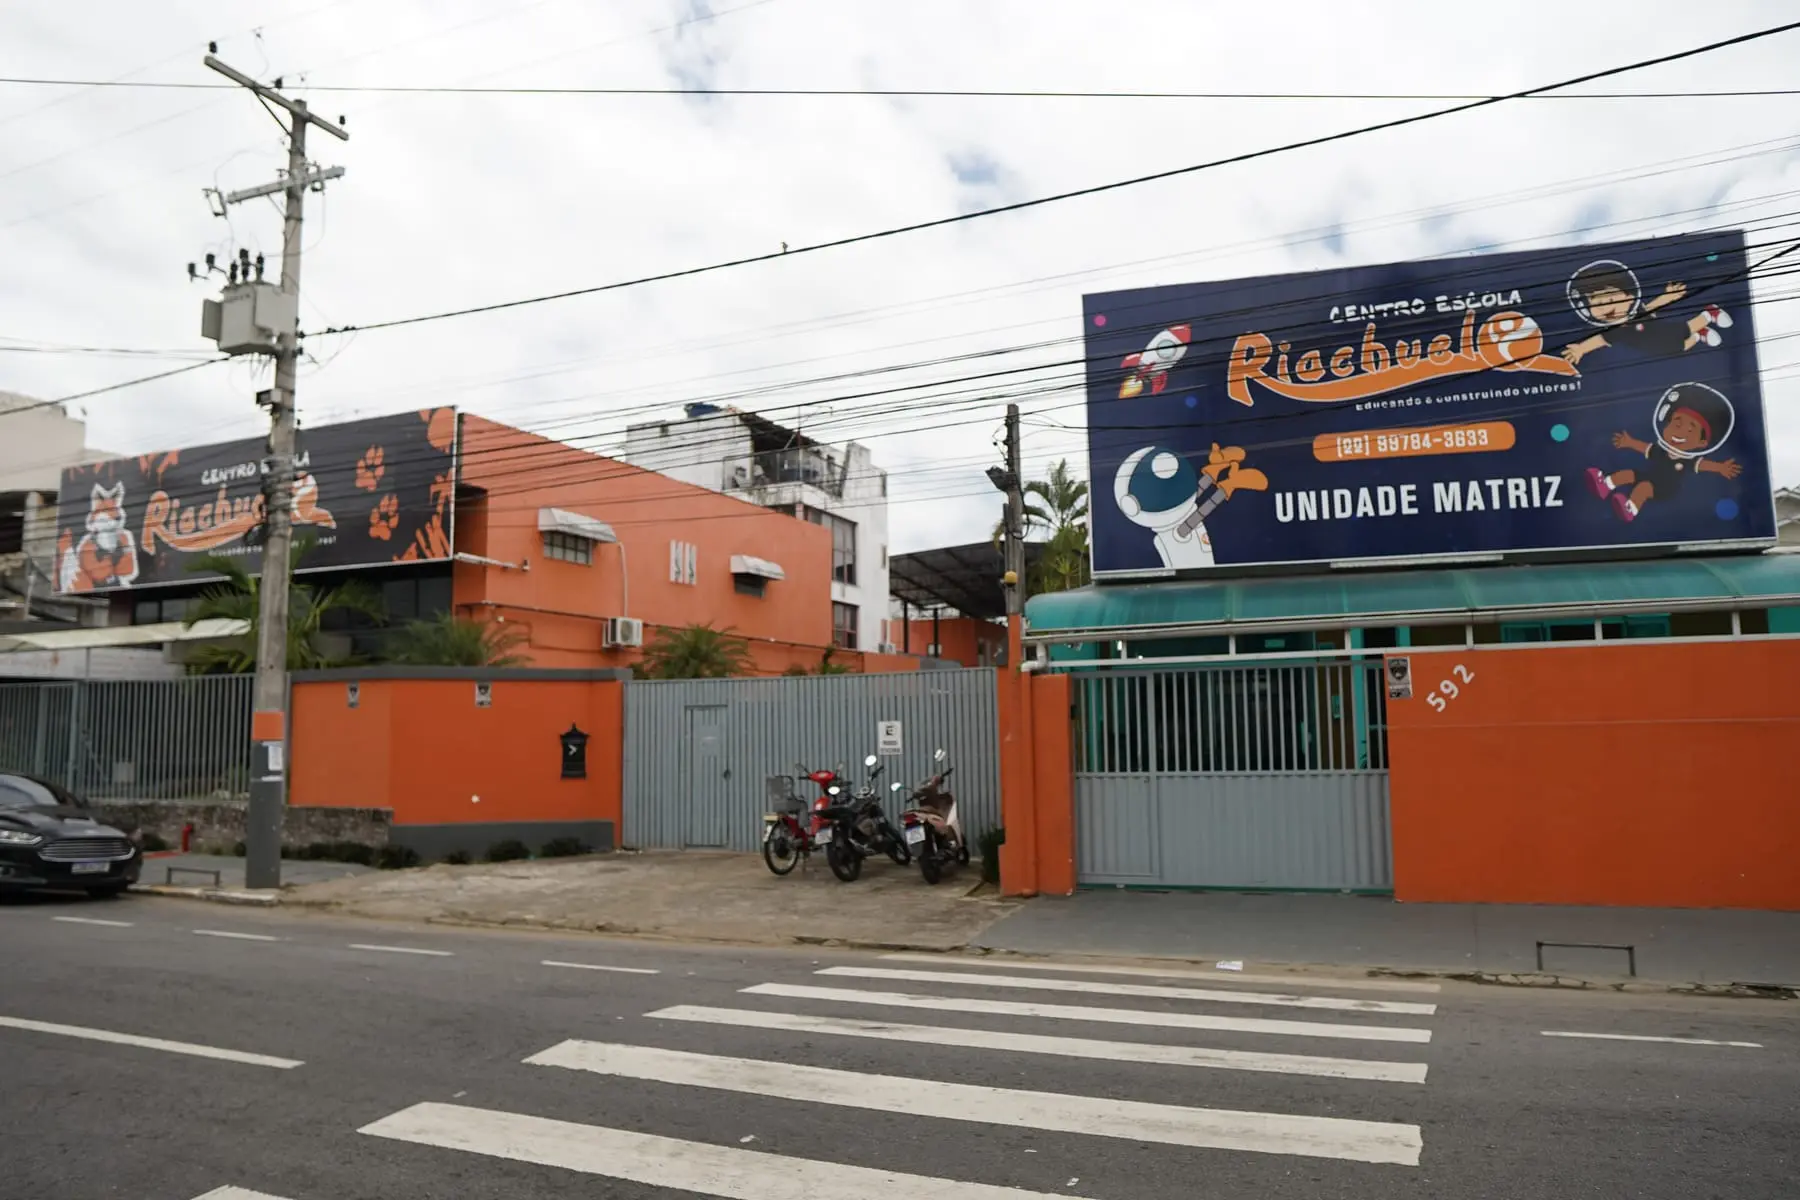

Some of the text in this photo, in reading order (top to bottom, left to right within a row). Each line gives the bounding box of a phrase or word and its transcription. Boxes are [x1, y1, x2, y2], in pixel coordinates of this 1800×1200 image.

[1329, 289, 1522, 323] CENTRO ESCOLA
[1436, 386, 1520, 403] construindo
[1523, 380, 1582, 395] valores!
[1377, 429, 1489, 452] 99784-3633
[201, 462, 256, 485] CENTRO
[1275, 475, 1564, 522] UNIDADE MATRIZ
[1426, 664, 1475, 713] 592
